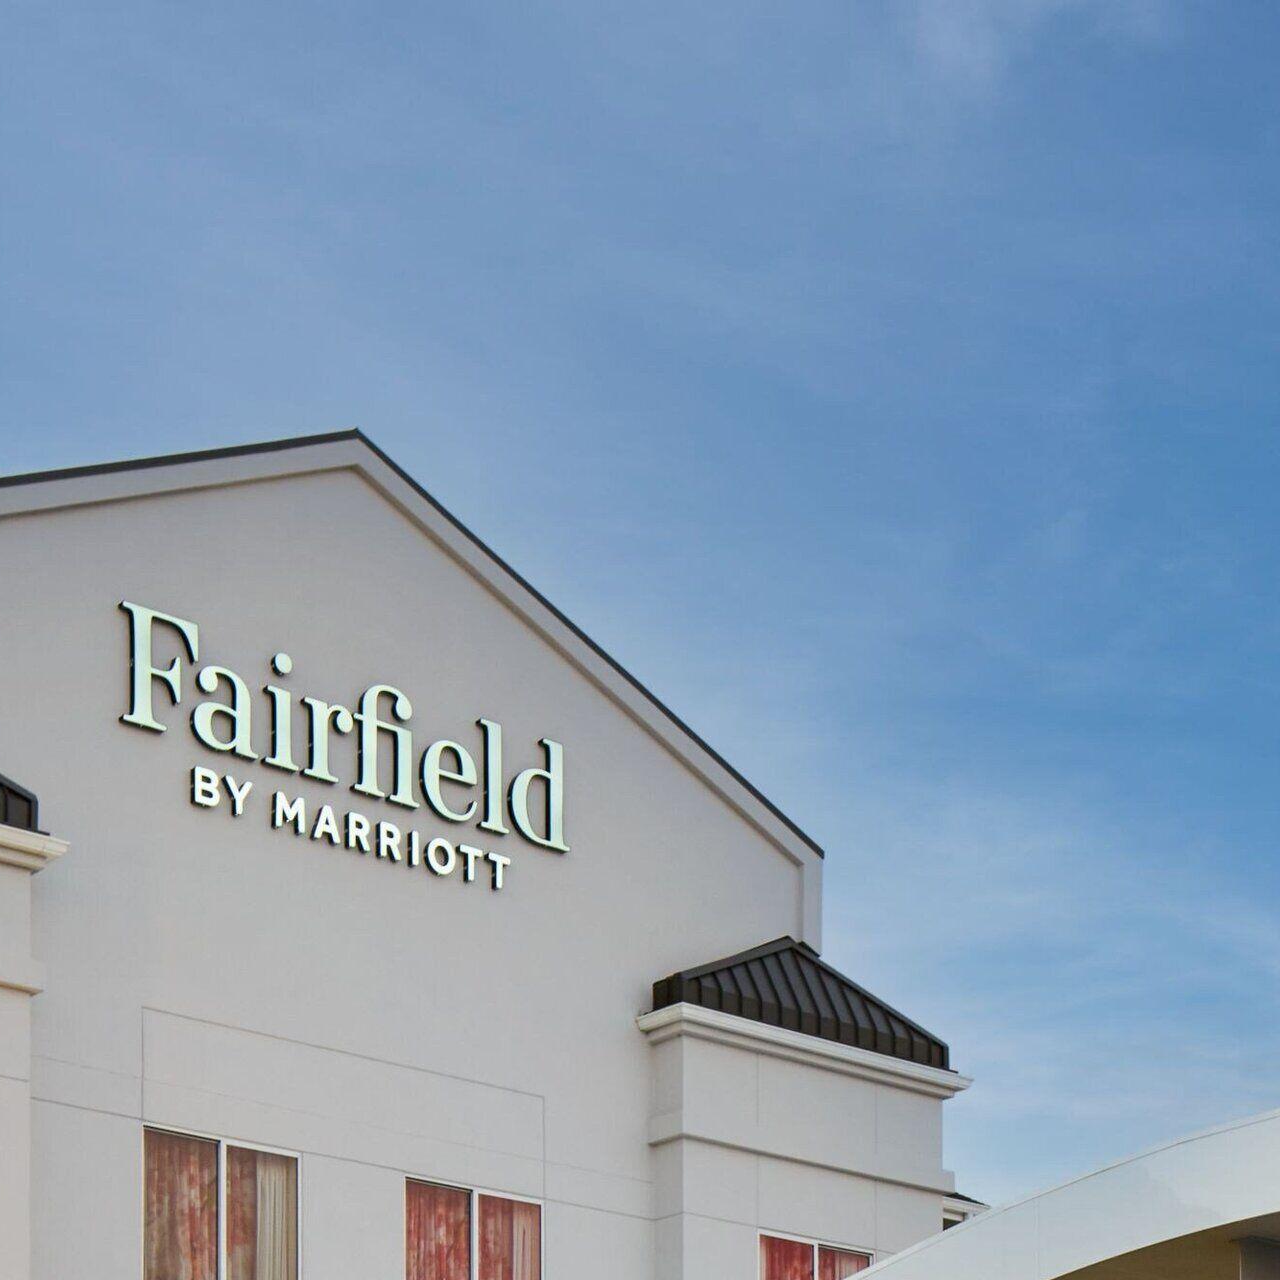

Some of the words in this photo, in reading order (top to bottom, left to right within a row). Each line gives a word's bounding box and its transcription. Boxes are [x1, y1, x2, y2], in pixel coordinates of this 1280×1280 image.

[118, 600, 570, 853] Fairfield
[191, 766, 253, 816] BY
[272, 791, 511, 889] MARRIOTT
